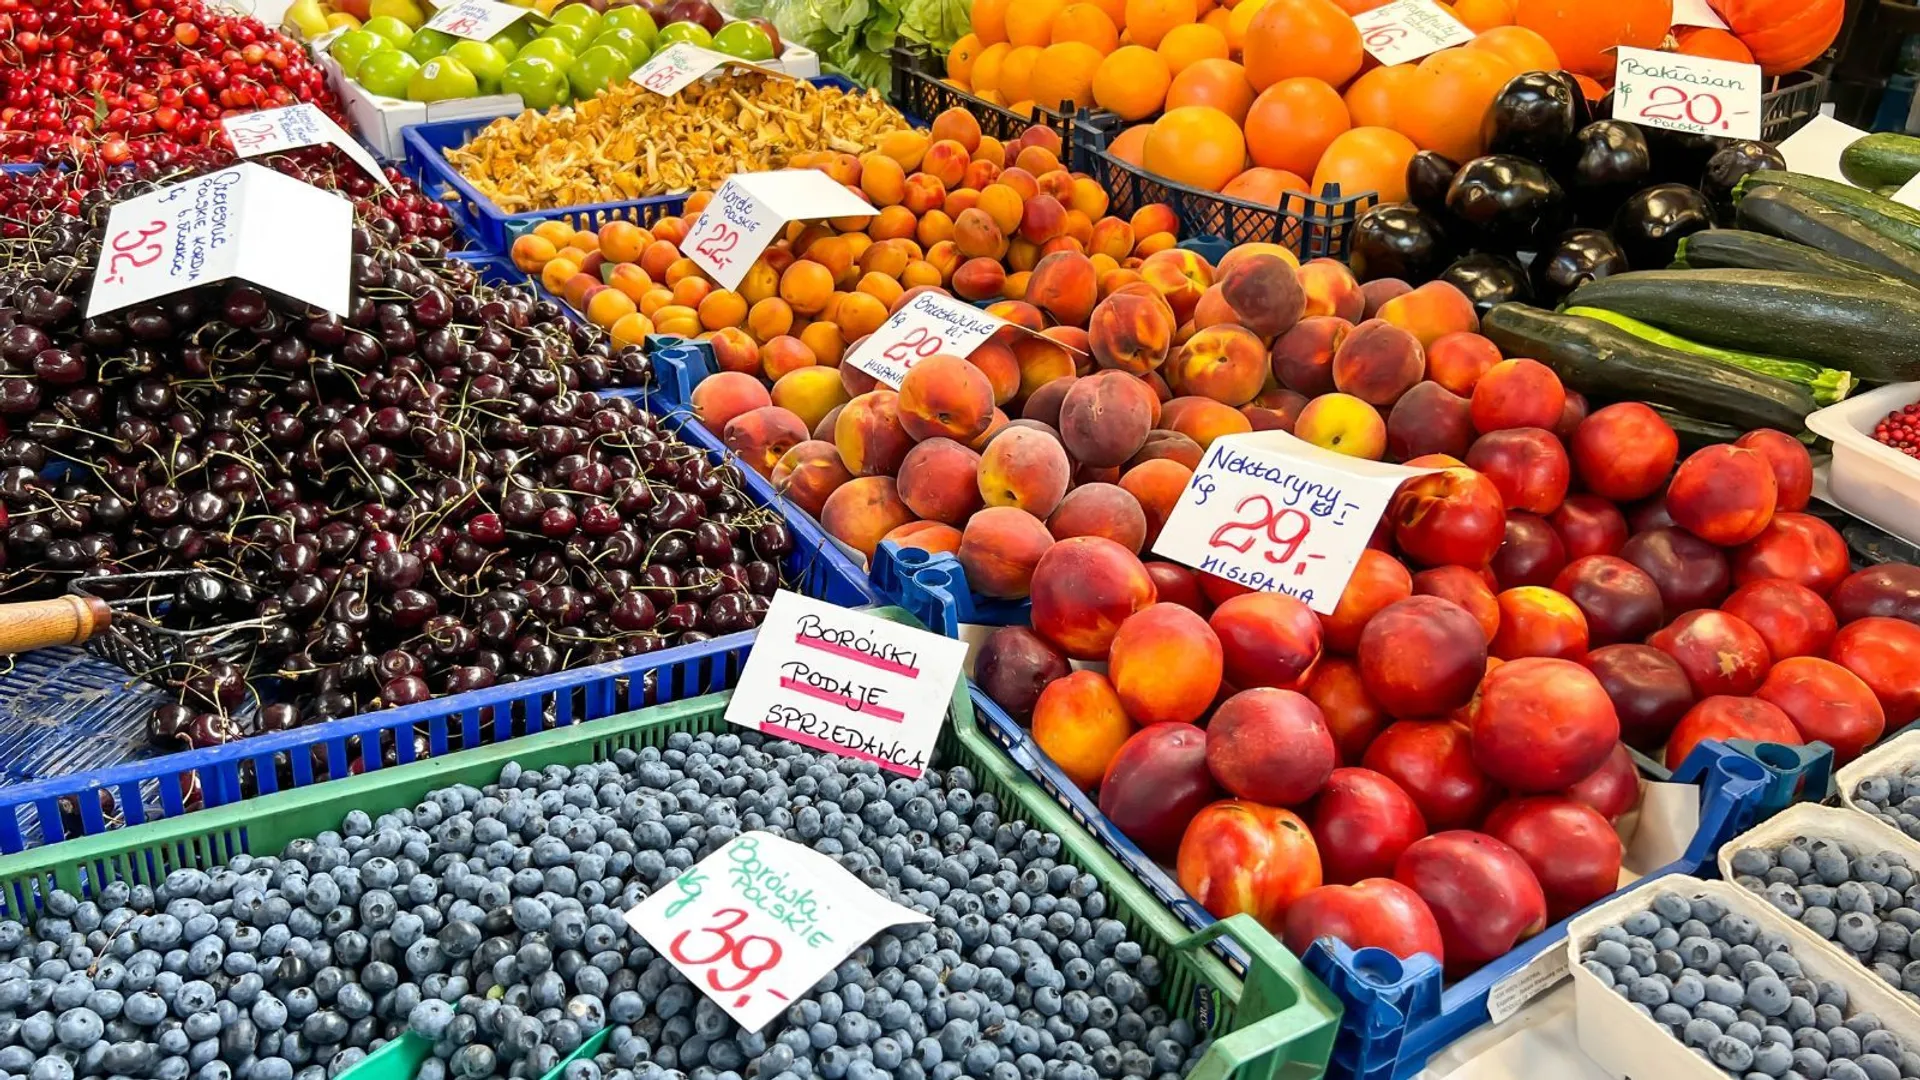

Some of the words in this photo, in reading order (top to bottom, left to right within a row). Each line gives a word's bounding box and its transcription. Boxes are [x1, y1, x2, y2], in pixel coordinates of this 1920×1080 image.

[195, 178, 213, 230] POLSKIE
[103, 219, 168, 285] 32,-
[1207, 444, 1342, 506] Nektaryny
[1208, 493, 1326, 576] 29,-
[796, 613, 918, 670] BORÓWKI
[780, 660, 889, 712] PODAJE
[765, 703, 926, 771] SPRZEDAWCA
[727, 836, 826, 923] Borówki
[728, 866, 834, 949] POLSKIE
[669, 907, 791, 1009] 39,-
